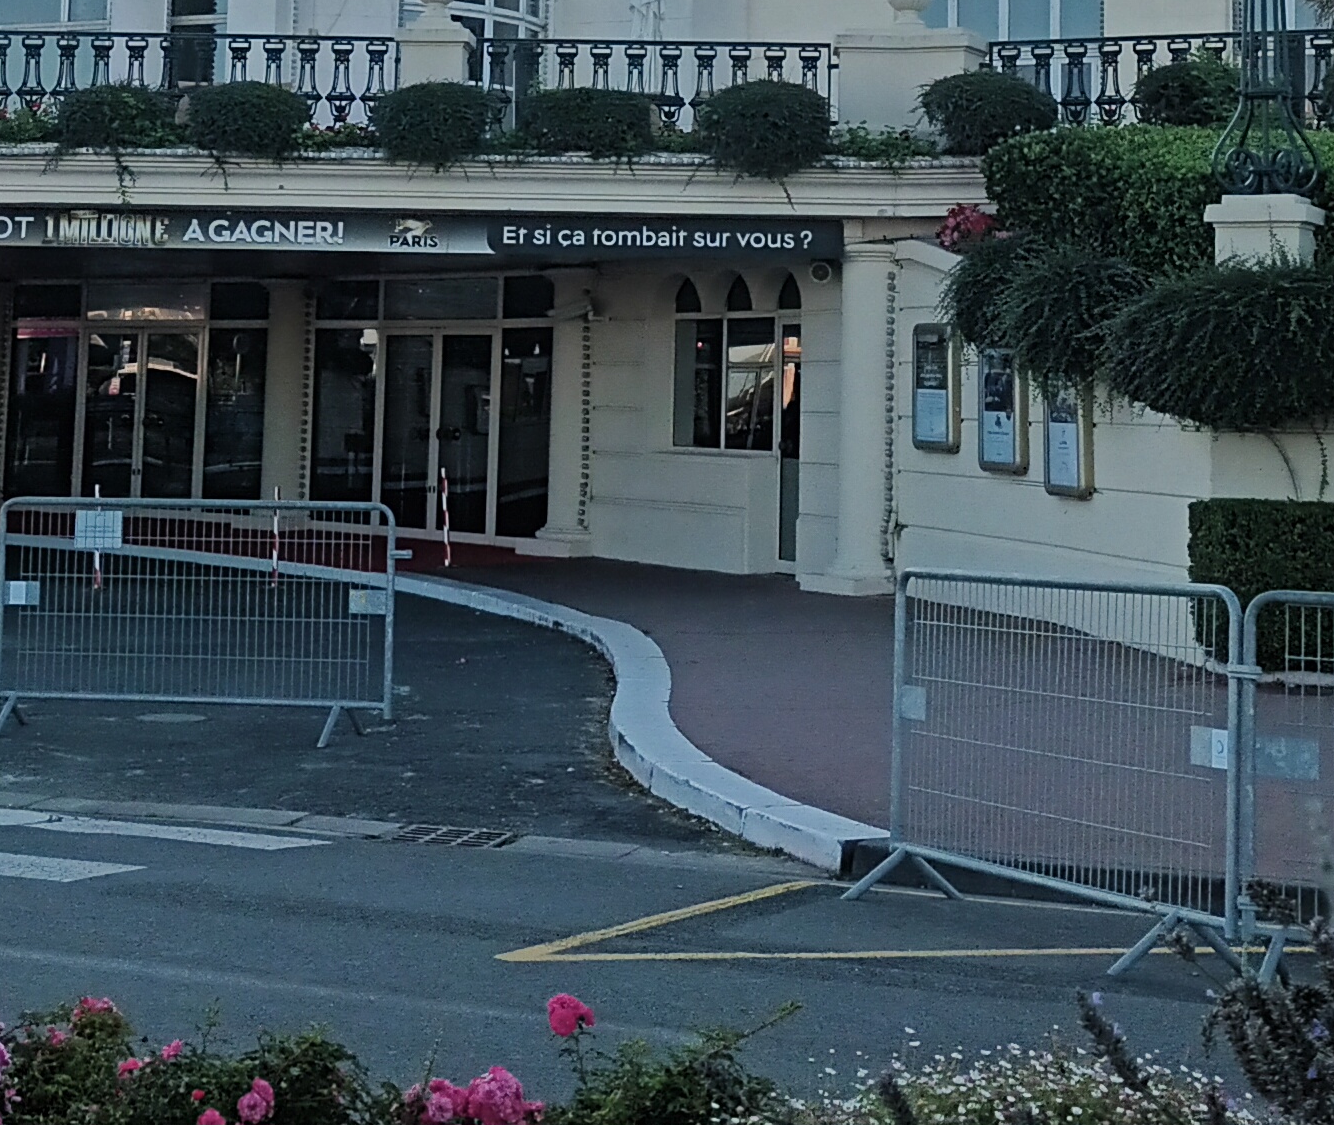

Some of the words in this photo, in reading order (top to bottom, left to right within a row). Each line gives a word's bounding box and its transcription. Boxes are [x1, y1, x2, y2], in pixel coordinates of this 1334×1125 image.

[208, 219, 344, 245] GAGNER!
[389, 235, 439, 248] PARIS
[502, 226, 528, 245] Et
[532, 223, 552, 245] si
[557, 229, 585, 248] ça
[592, 225, 688, 247] tombait
[692, 230, 732, 248] sur
[736, 232, 796, 249] vous
